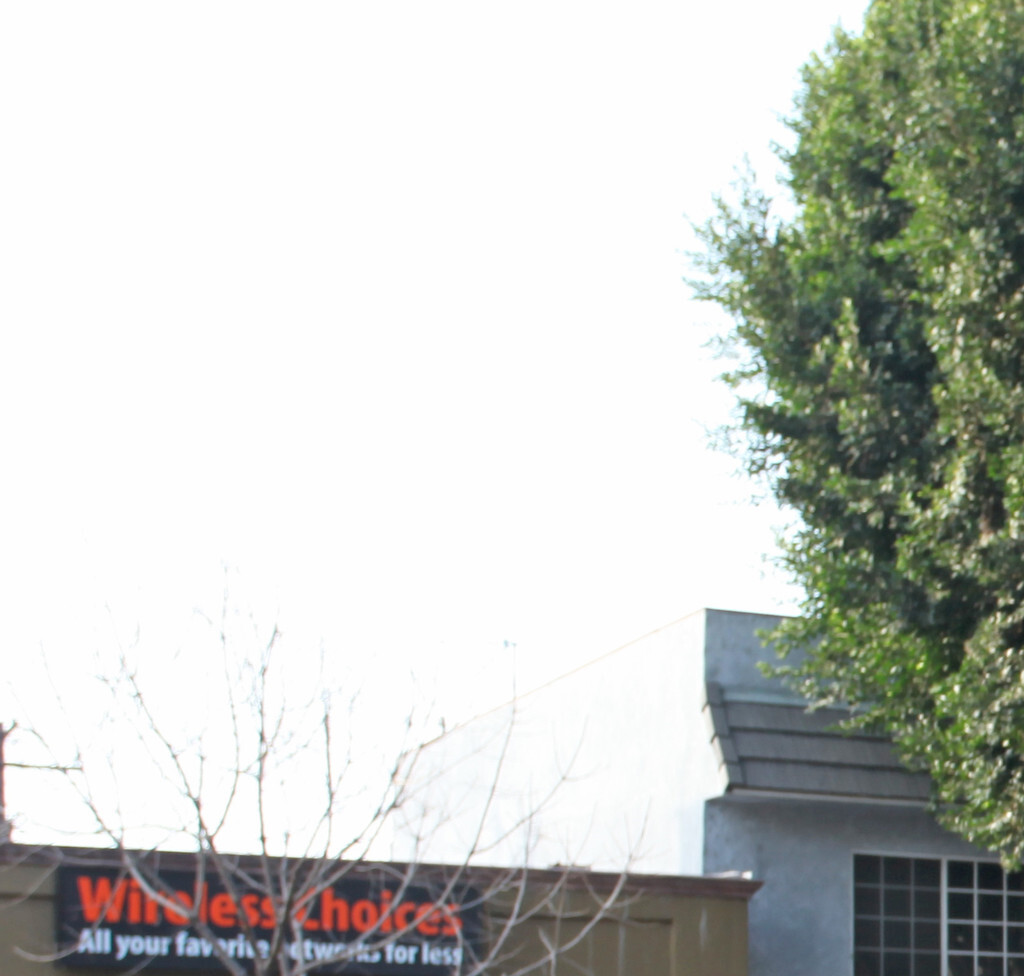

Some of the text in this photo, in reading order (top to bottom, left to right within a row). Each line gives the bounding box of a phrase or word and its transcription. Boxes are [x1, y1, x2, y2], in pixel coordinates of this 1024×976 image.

[77, 876, 284, 929] Wireless
[78, 929, 112, 954] All
[115, 935, 172, 960] your
[278, 938, 382, 963] etwoks
[385, 942, 419, 964] for
[421, 943, 464, 966] less
